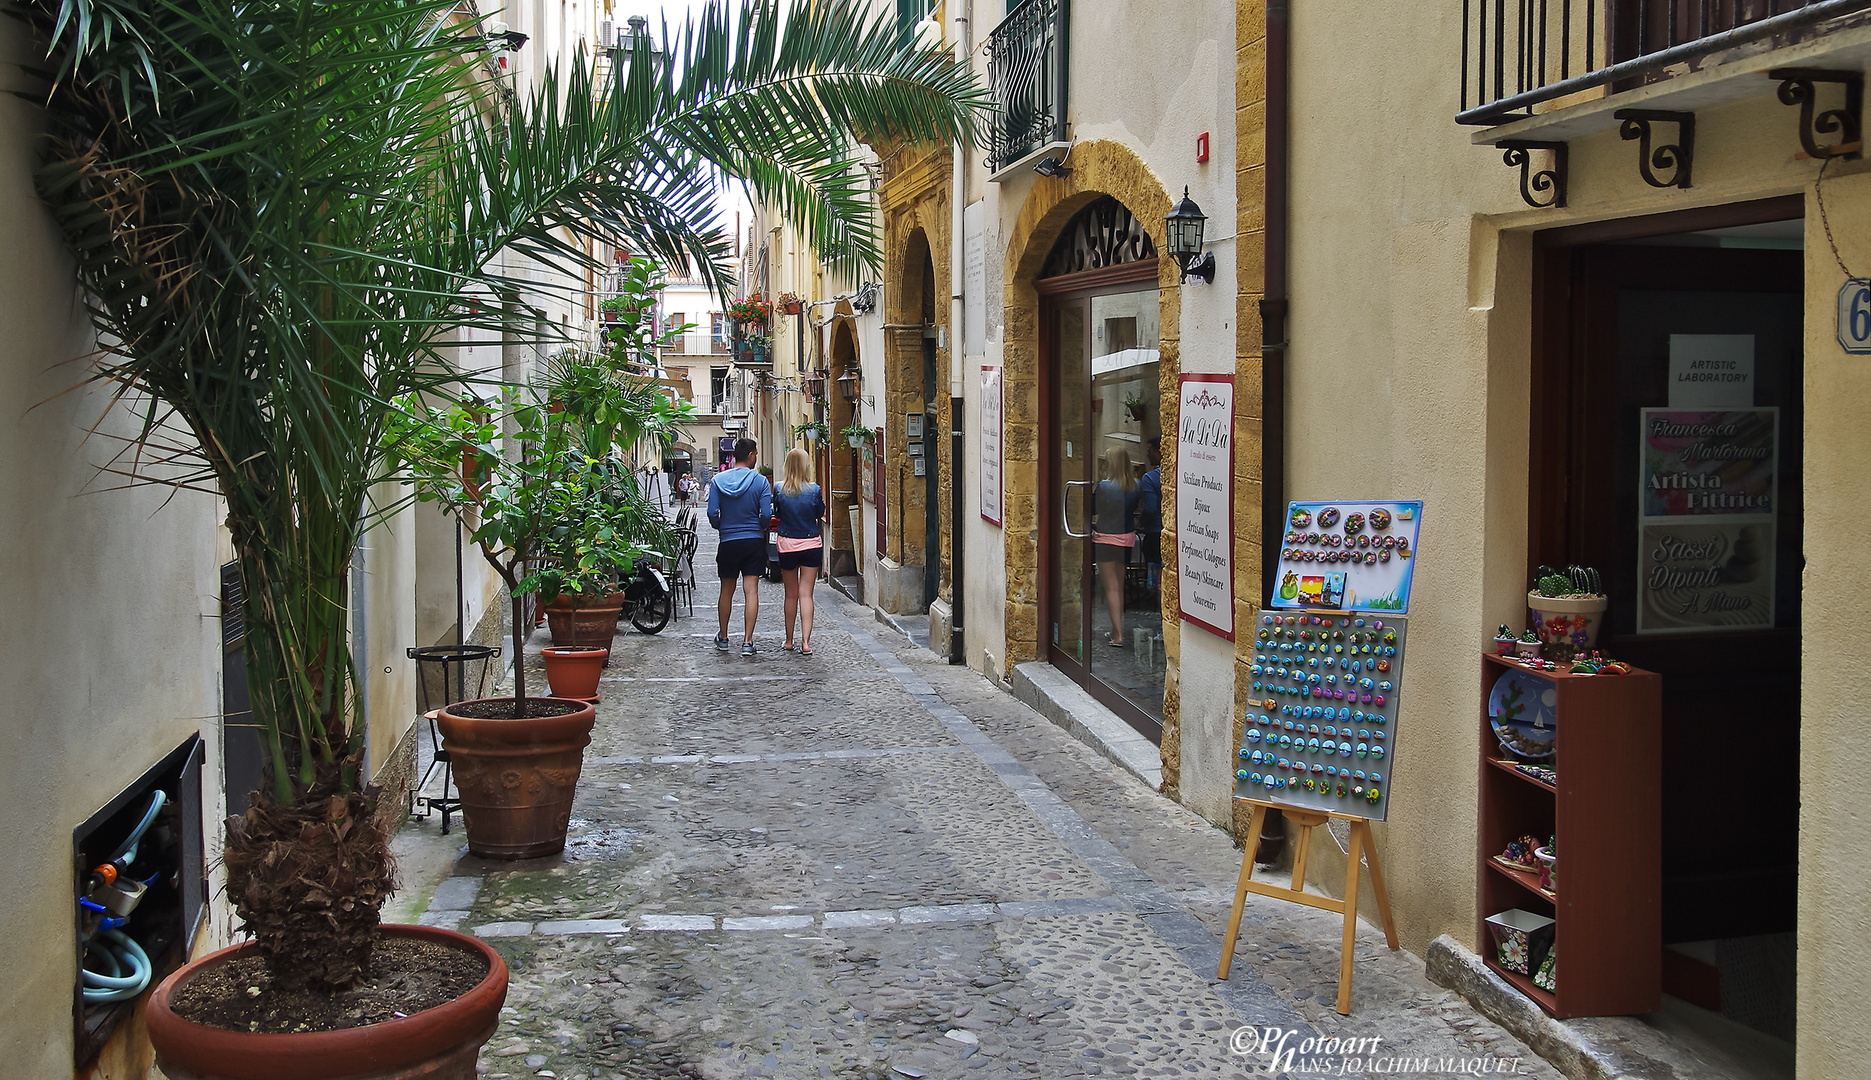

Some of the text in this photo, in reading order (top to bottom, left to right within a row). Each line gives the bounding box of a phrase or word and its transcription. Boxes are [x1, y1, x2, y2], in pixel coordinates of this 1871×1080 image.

[1690, 360, 1737, 370] ARTISTIC
[1678, 372, 1748, 383] LABORATORY
[1181, 415, 1195, 444] La
[1197, 417, 1211, 446] Di
[1651, 418, 1736, 436] Francesca
[1682, 443, 1767, 461] Martorana
[1183, 471, 1223, 492] Sicilian Products
[1648, 470, 1721, 489] Artista
[1194, 497, 1211, 516] Bijoux
[1687, 490, 1769, 509] Pittrice
[1186, 519, 1220, 544] Artisan Soaps
[1651, 534, 1718, 562] Sassi
[1647, 564, 1721, 592] Dipinti
[1192, 590, 1217, 612] Souvenirs
[1679, 592, 1751, 614] A Mano
